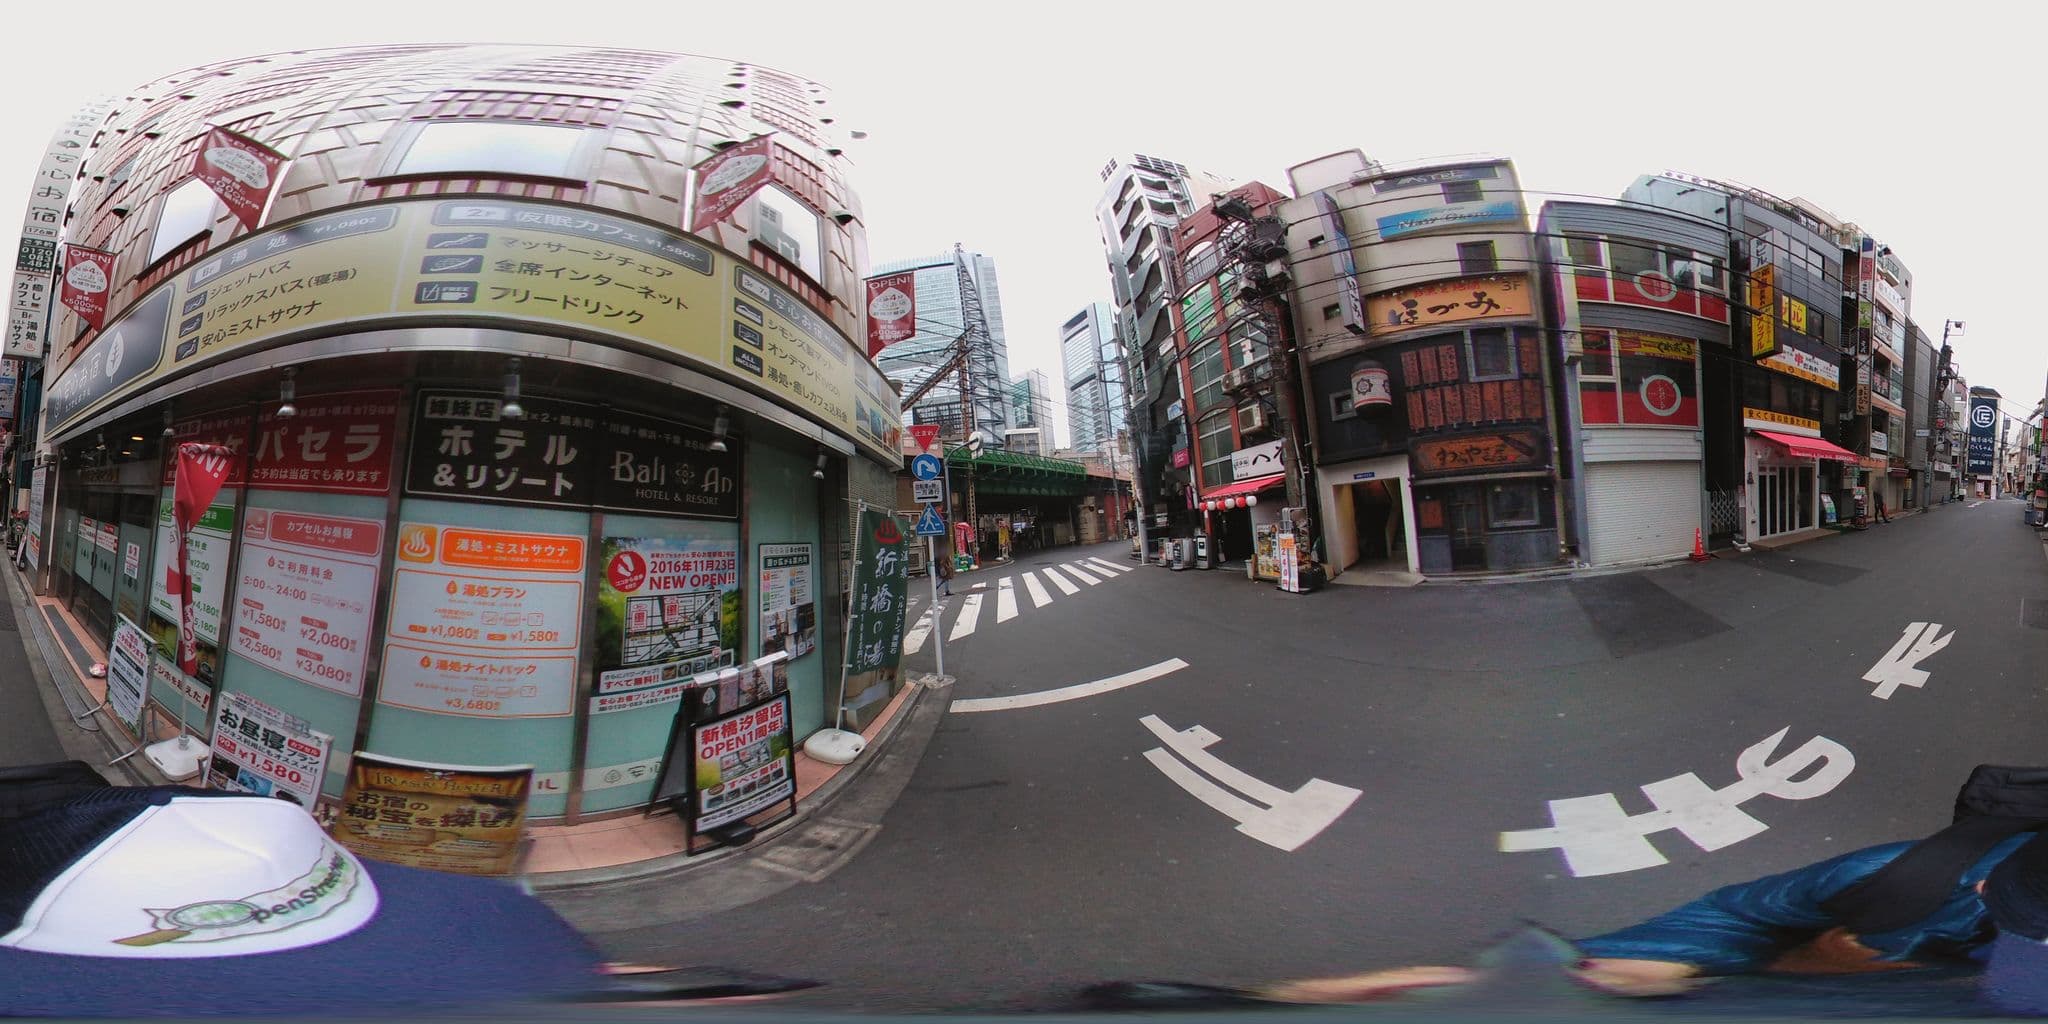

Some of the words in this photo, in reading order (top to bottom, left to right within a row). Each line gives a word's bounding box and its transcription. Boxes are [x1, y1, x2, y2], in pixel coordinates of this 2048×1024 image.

[70, 249, 111, 264] OPEN!
[502, 236, 673, 278] マッサージチェア
[210, 261, 291, 299] ジェットバス
[494, 259, 689, 311] 全席インターネット
[868, 276, 910, 289] OPEN!
[1501, 281, 1521, 291] 3F
[490, 286, 645, 323] フリードリンク
[1388, 291, 1501, 325] ほづみ
[201, 300, 323, 348] 安心ミストサウナ
[255, 423, 381, 463] パセラ
[438, 424, 578, 467] ホテル
[252, 468, 381, 483] ご予約は当店でも承ります
[433, 463, 574, 497] &リゾート
[636, 488, 669, 501] HOTEL
[686, 494, 719, 506] RESORT
[286, 521, 354, 540] カプセルお昼寝
[456, 538, 569, 558] 湯処・ミストサウナ
[277, 560, 334, 581] ご利用料金
[650, 558, 736, 575] 2016年11月23日
[462, 583, 527, 599] 湯処プラン
[649, 575, 686, 591] NEW
[690, 571, 736, 588] OPEN!!
[864, 546, 898, 666] 新橋の湯
[242, 609, 281, 631] ¥1,580
[300, 628, 350, 652] ¥2,080
[431, 624, 473, 640] ¥1,080
[510, 630, 553, 642] ¥1,580
[240, 637, 277, 659] ¥2,580
[296, 659, 346, 682] ¥3,080
[435, 658, 537, 675] 湯処ナイトパック
[219, 708, 287, 754] お昼寝
[701, 701, 783, 745] 新橋汐留店
[701, 716, 784, 760] OPEN1周年!
[238, 750, 302, 784] ¥1,580
[358, 791, 430, 812] お宿の
